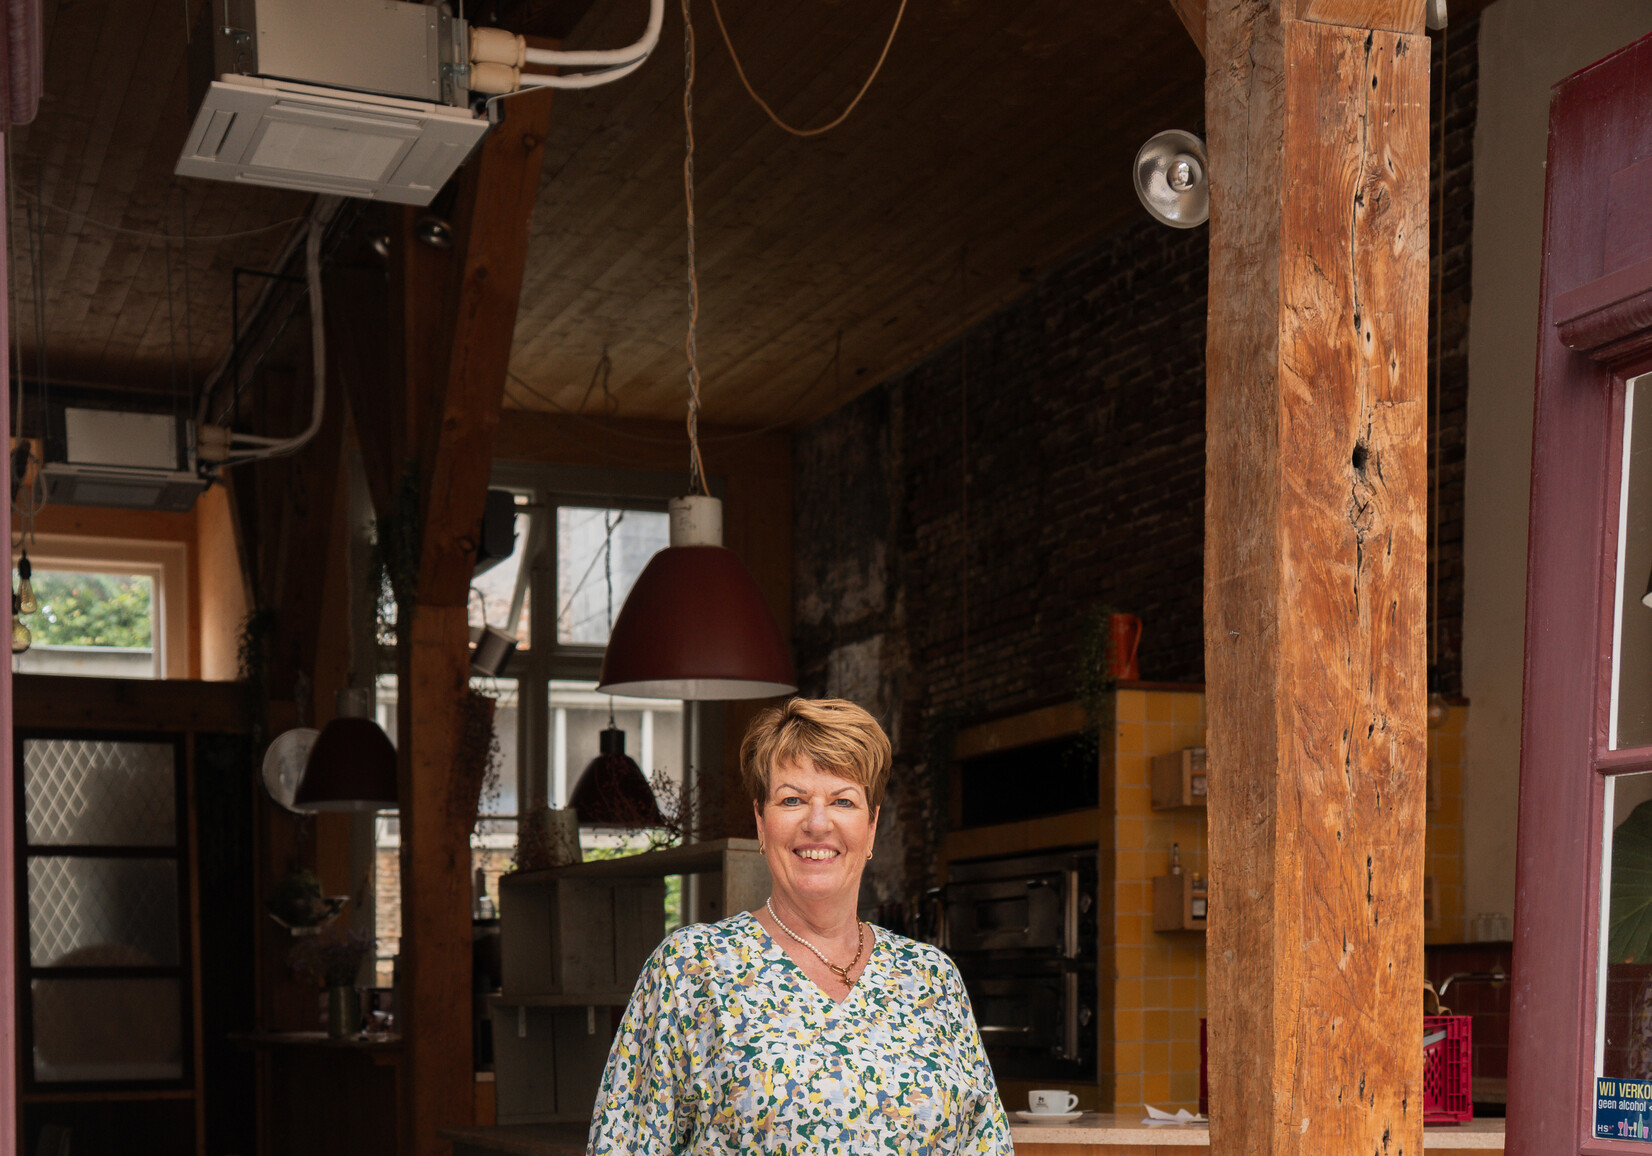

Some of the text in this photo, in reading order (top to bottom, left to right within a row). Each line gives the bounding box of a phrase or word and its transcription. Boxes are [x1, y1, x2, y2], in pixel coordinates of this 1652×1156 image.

[1599, 1081, 1616, 1097] WIJ
[1598, 1099, 1647, 1112] geen alcohol
